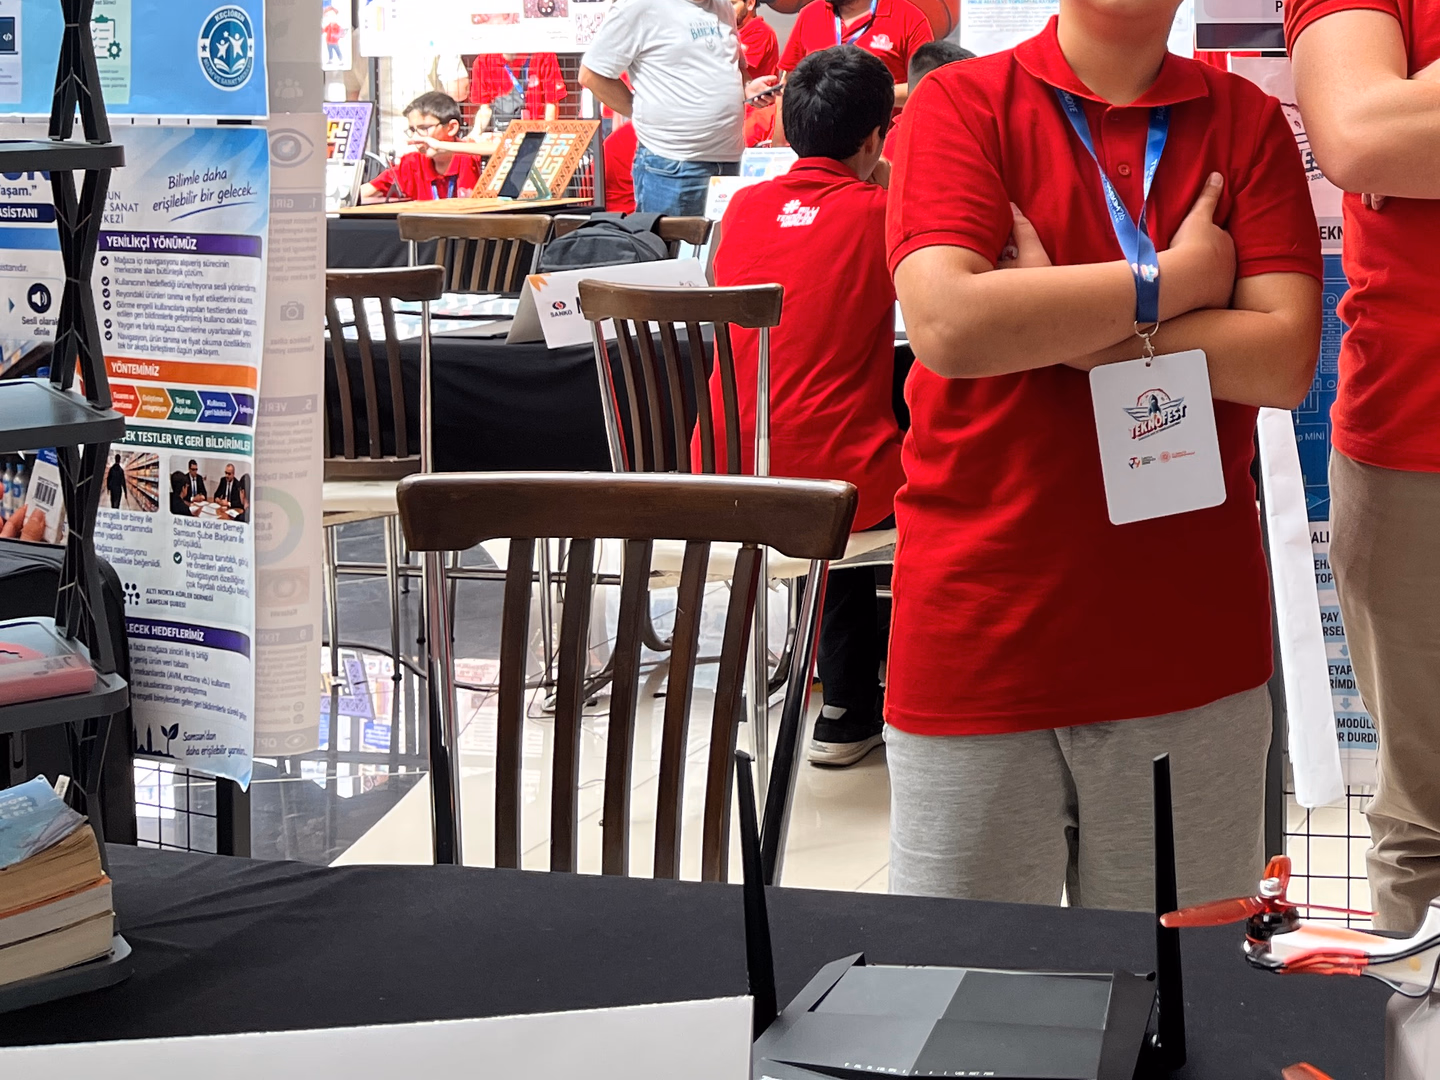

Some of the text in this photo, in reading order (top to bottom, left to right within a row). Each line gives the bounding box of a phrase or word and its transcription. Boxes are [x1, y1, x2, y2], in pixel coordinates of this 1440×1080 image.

[168, 167, 227, 190] Bilimle daha
[200, 189, 213, 202] bir
[1128, 403, 1188, 441] TEKNOFEST
[138, 432, 172, 444] TESTLER
[185, 436, 203, 447] GERİ
